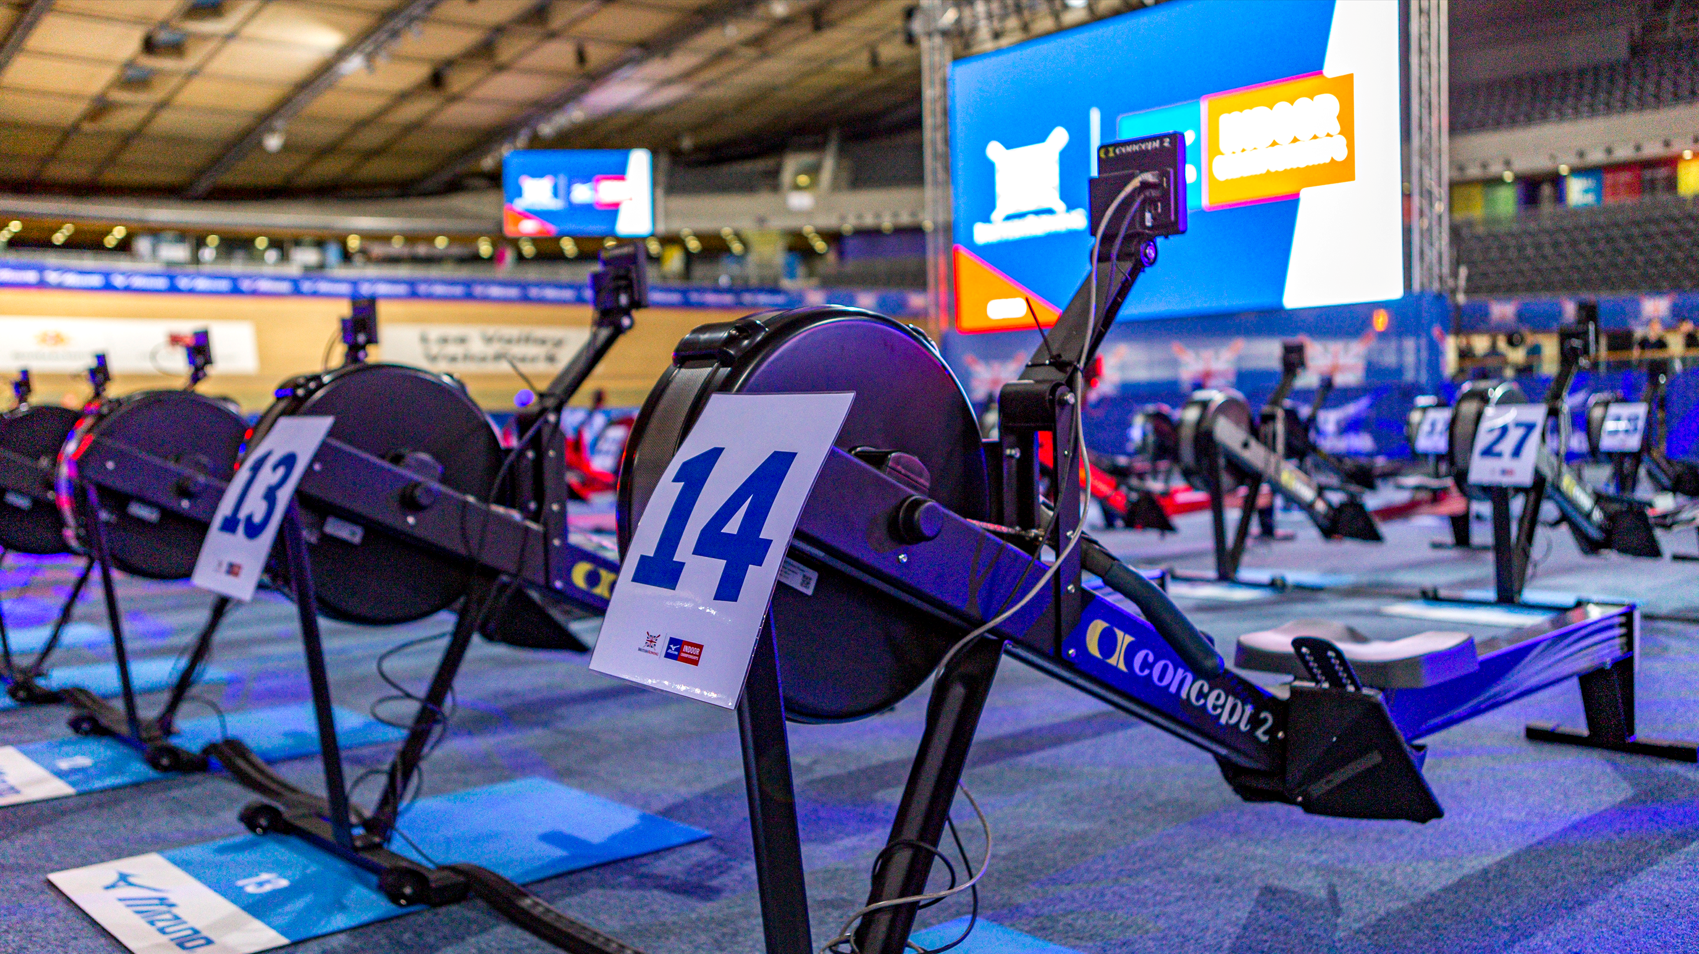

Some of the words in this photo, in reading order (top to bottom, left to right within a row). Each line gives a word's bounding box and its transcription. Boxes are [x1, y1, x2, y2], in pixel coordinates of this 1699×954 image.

[1479, 421, 1537, 460] 27
[218, 449, 298, 540] 13
[630, 446, 798, 603] 14
[1132, 647, 1256, 734] concept
[1254, 711, 1274, 744] 2
[235, 871, 291, 895] 13
